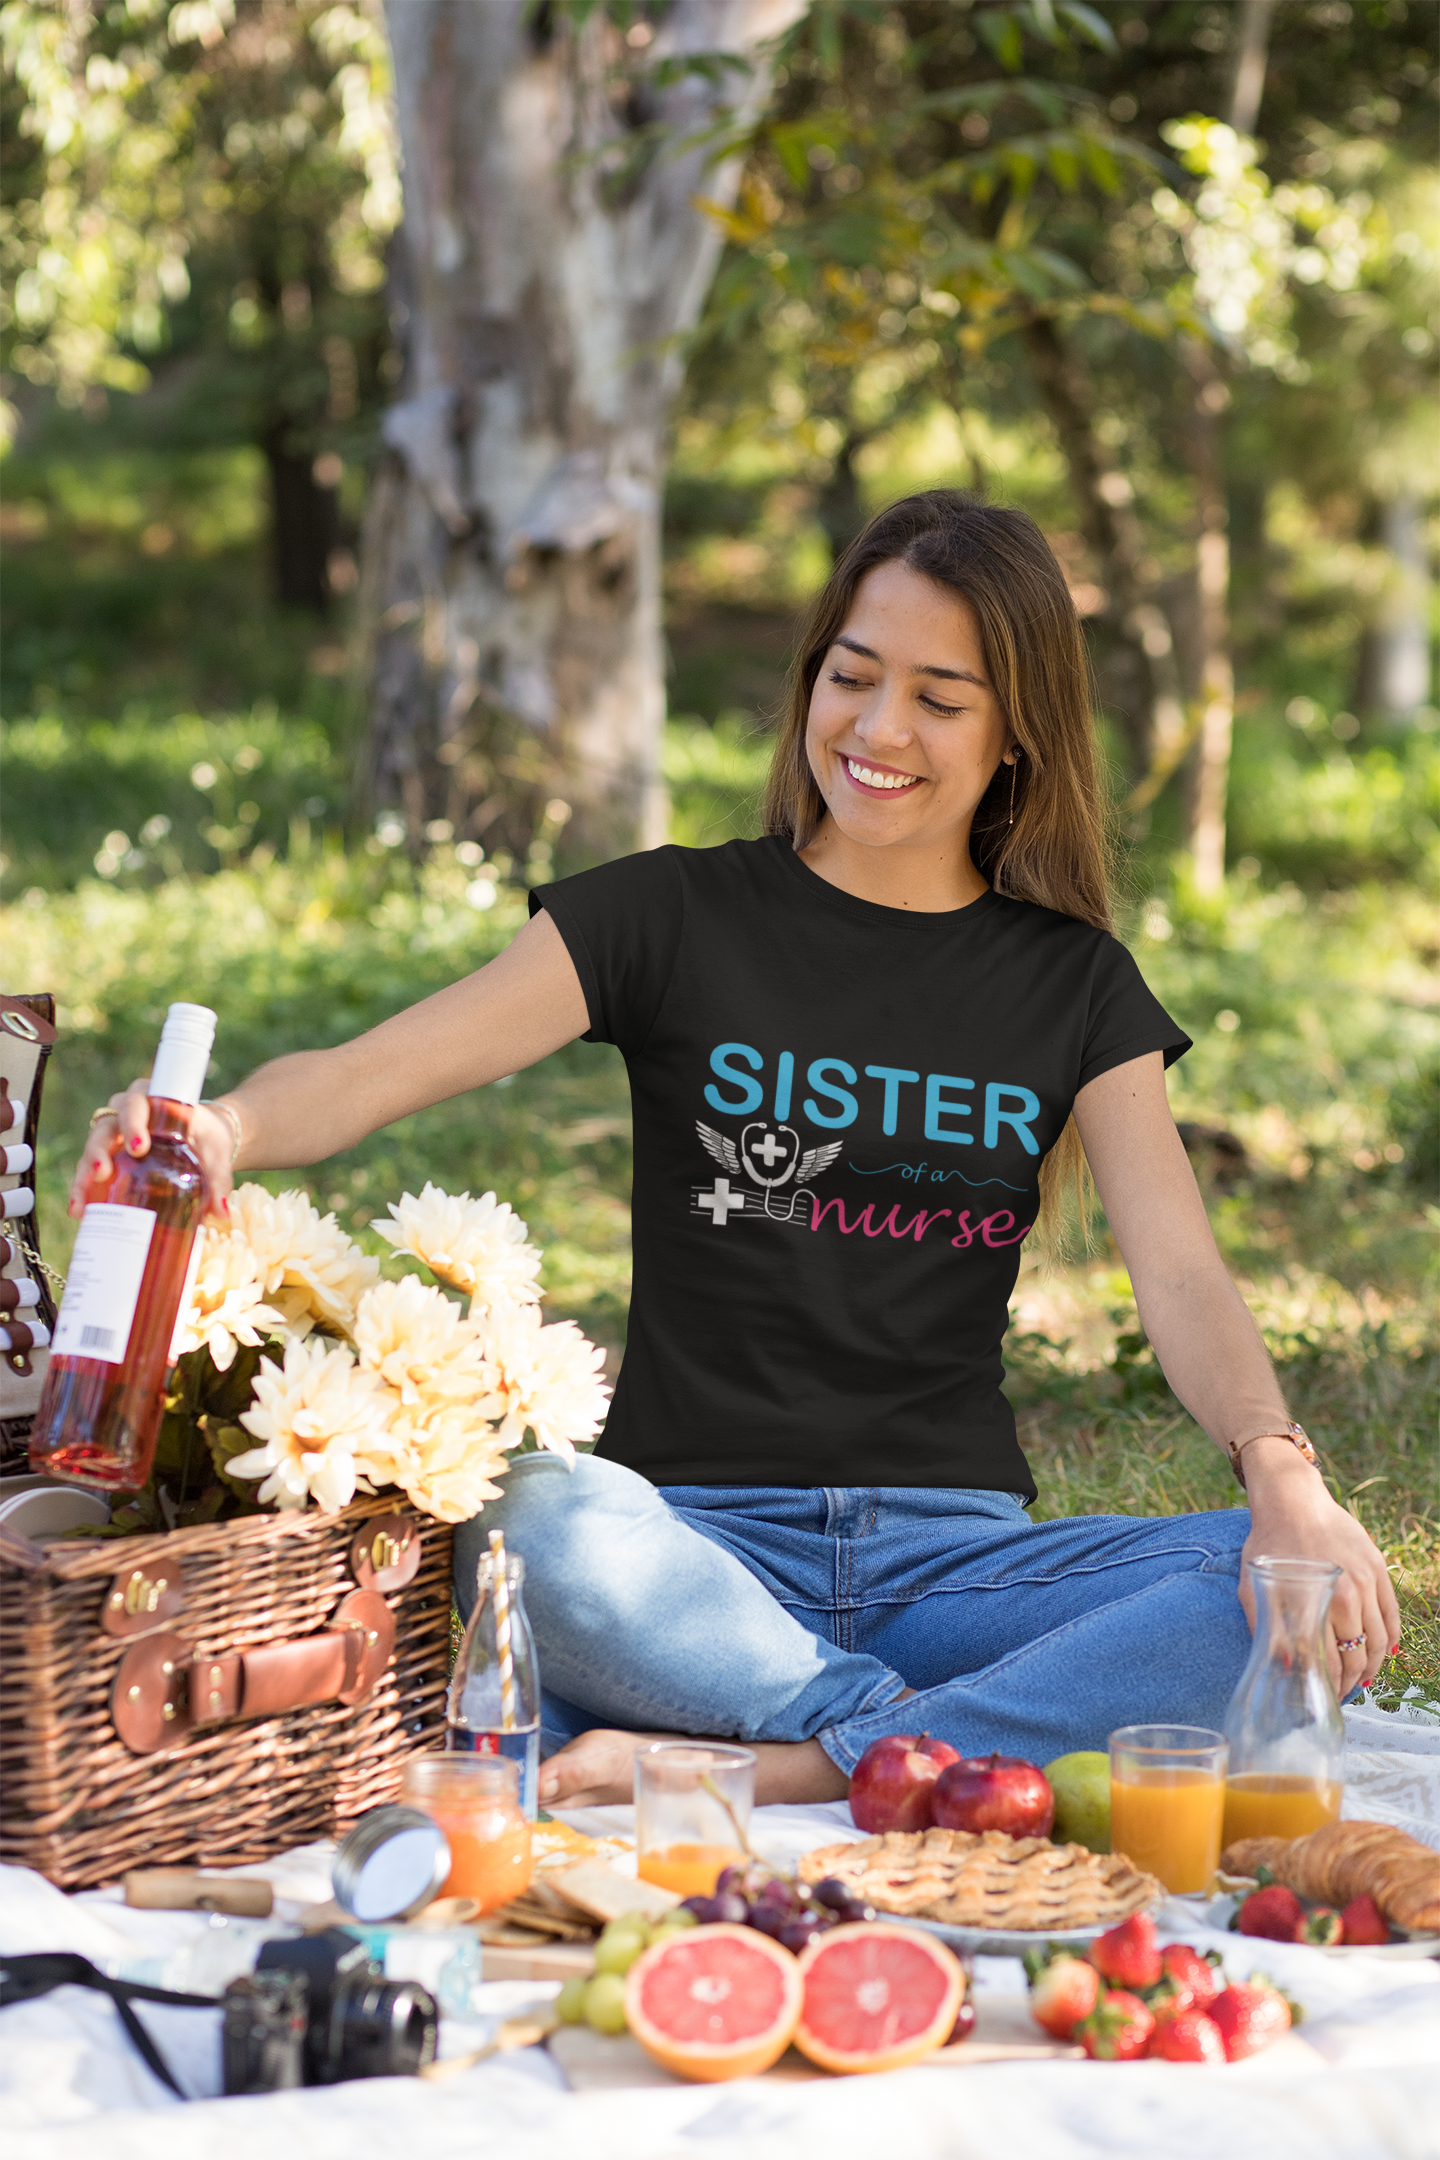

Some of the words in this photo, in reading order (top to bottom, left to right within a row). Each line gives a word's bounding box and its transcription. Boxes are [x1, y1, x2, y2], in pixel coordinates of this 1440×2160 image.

[703, 1042, 1041, 1156] SISTER
[901, 1162, 928, 1184] of
[930, 1169, 948, 1183] a
[810, 1197, 1032, 1248] nurse
